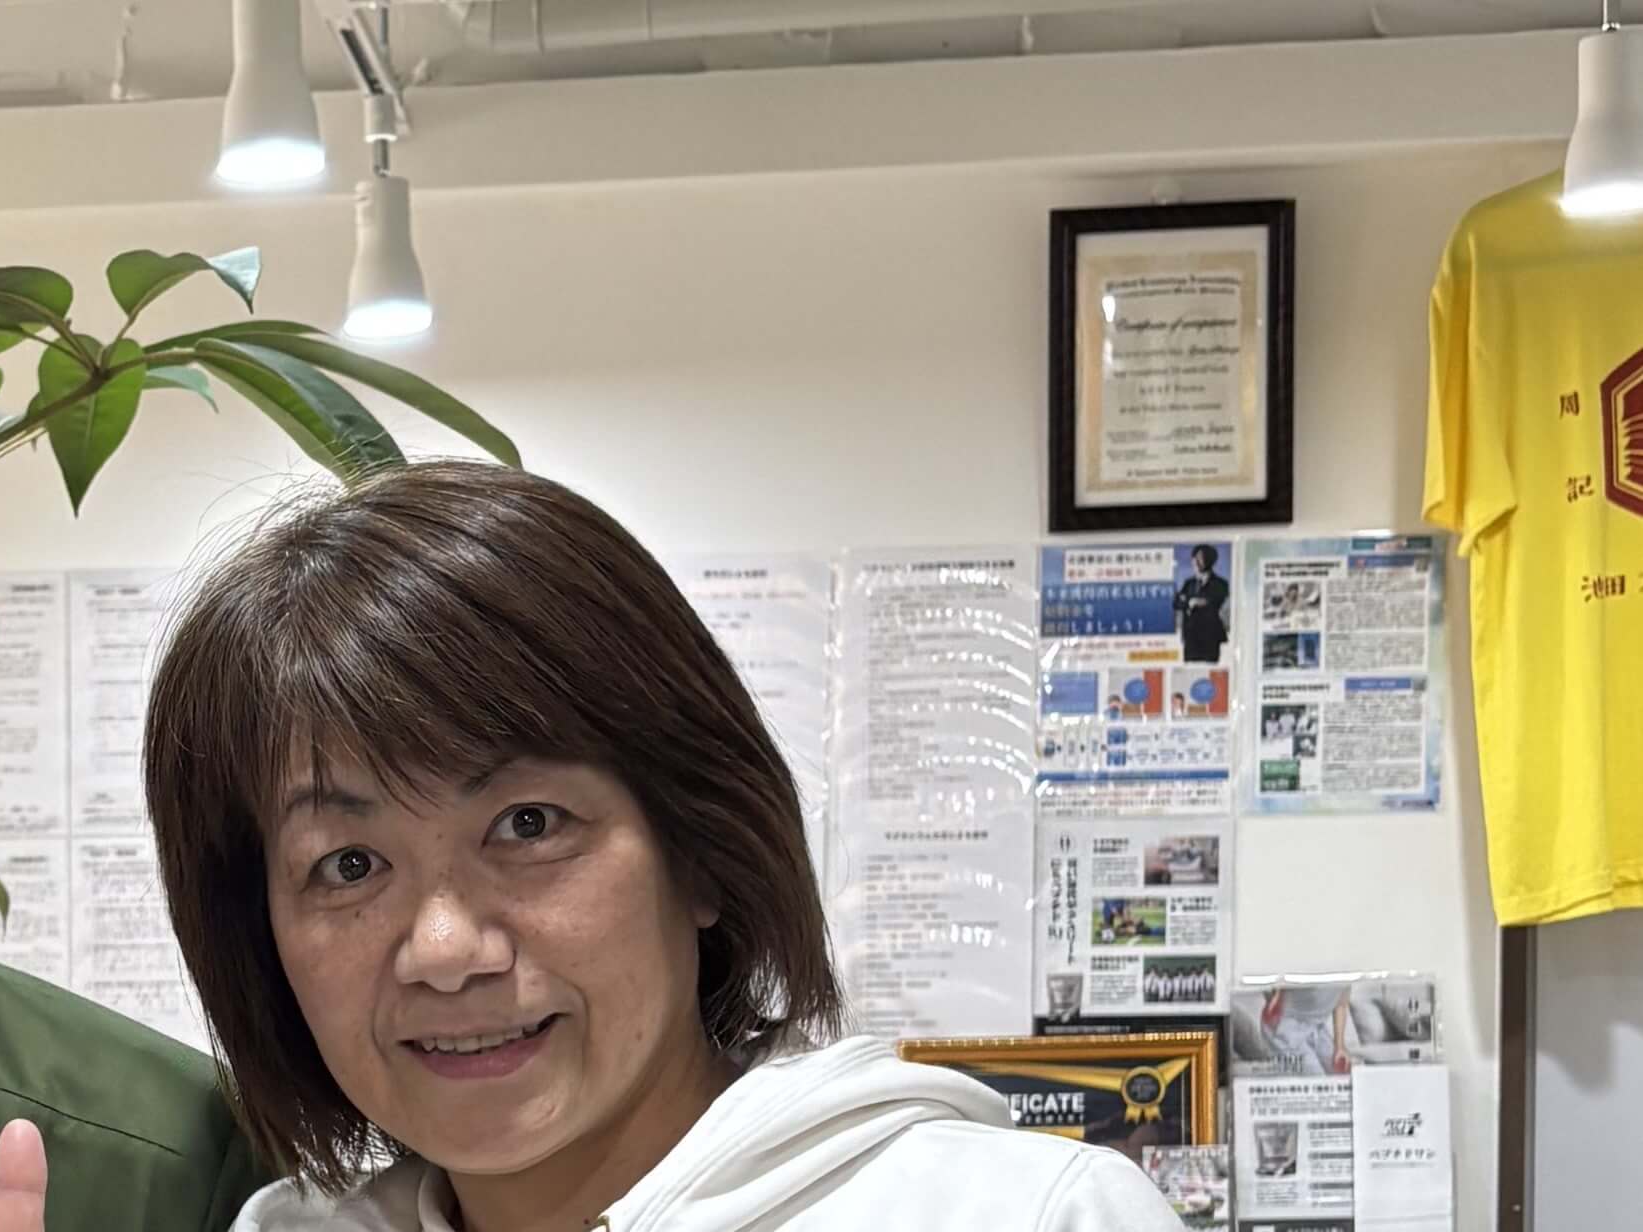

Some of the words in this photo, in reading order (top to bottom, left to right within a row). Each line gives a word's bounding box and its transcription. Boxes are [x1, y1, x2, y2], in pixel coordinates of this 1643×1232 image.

[1566, 474, 1595, 503] 記
[1581, 573, 1643, 603] 池田
[1008, 1092, 1086, 1114] FICATE
